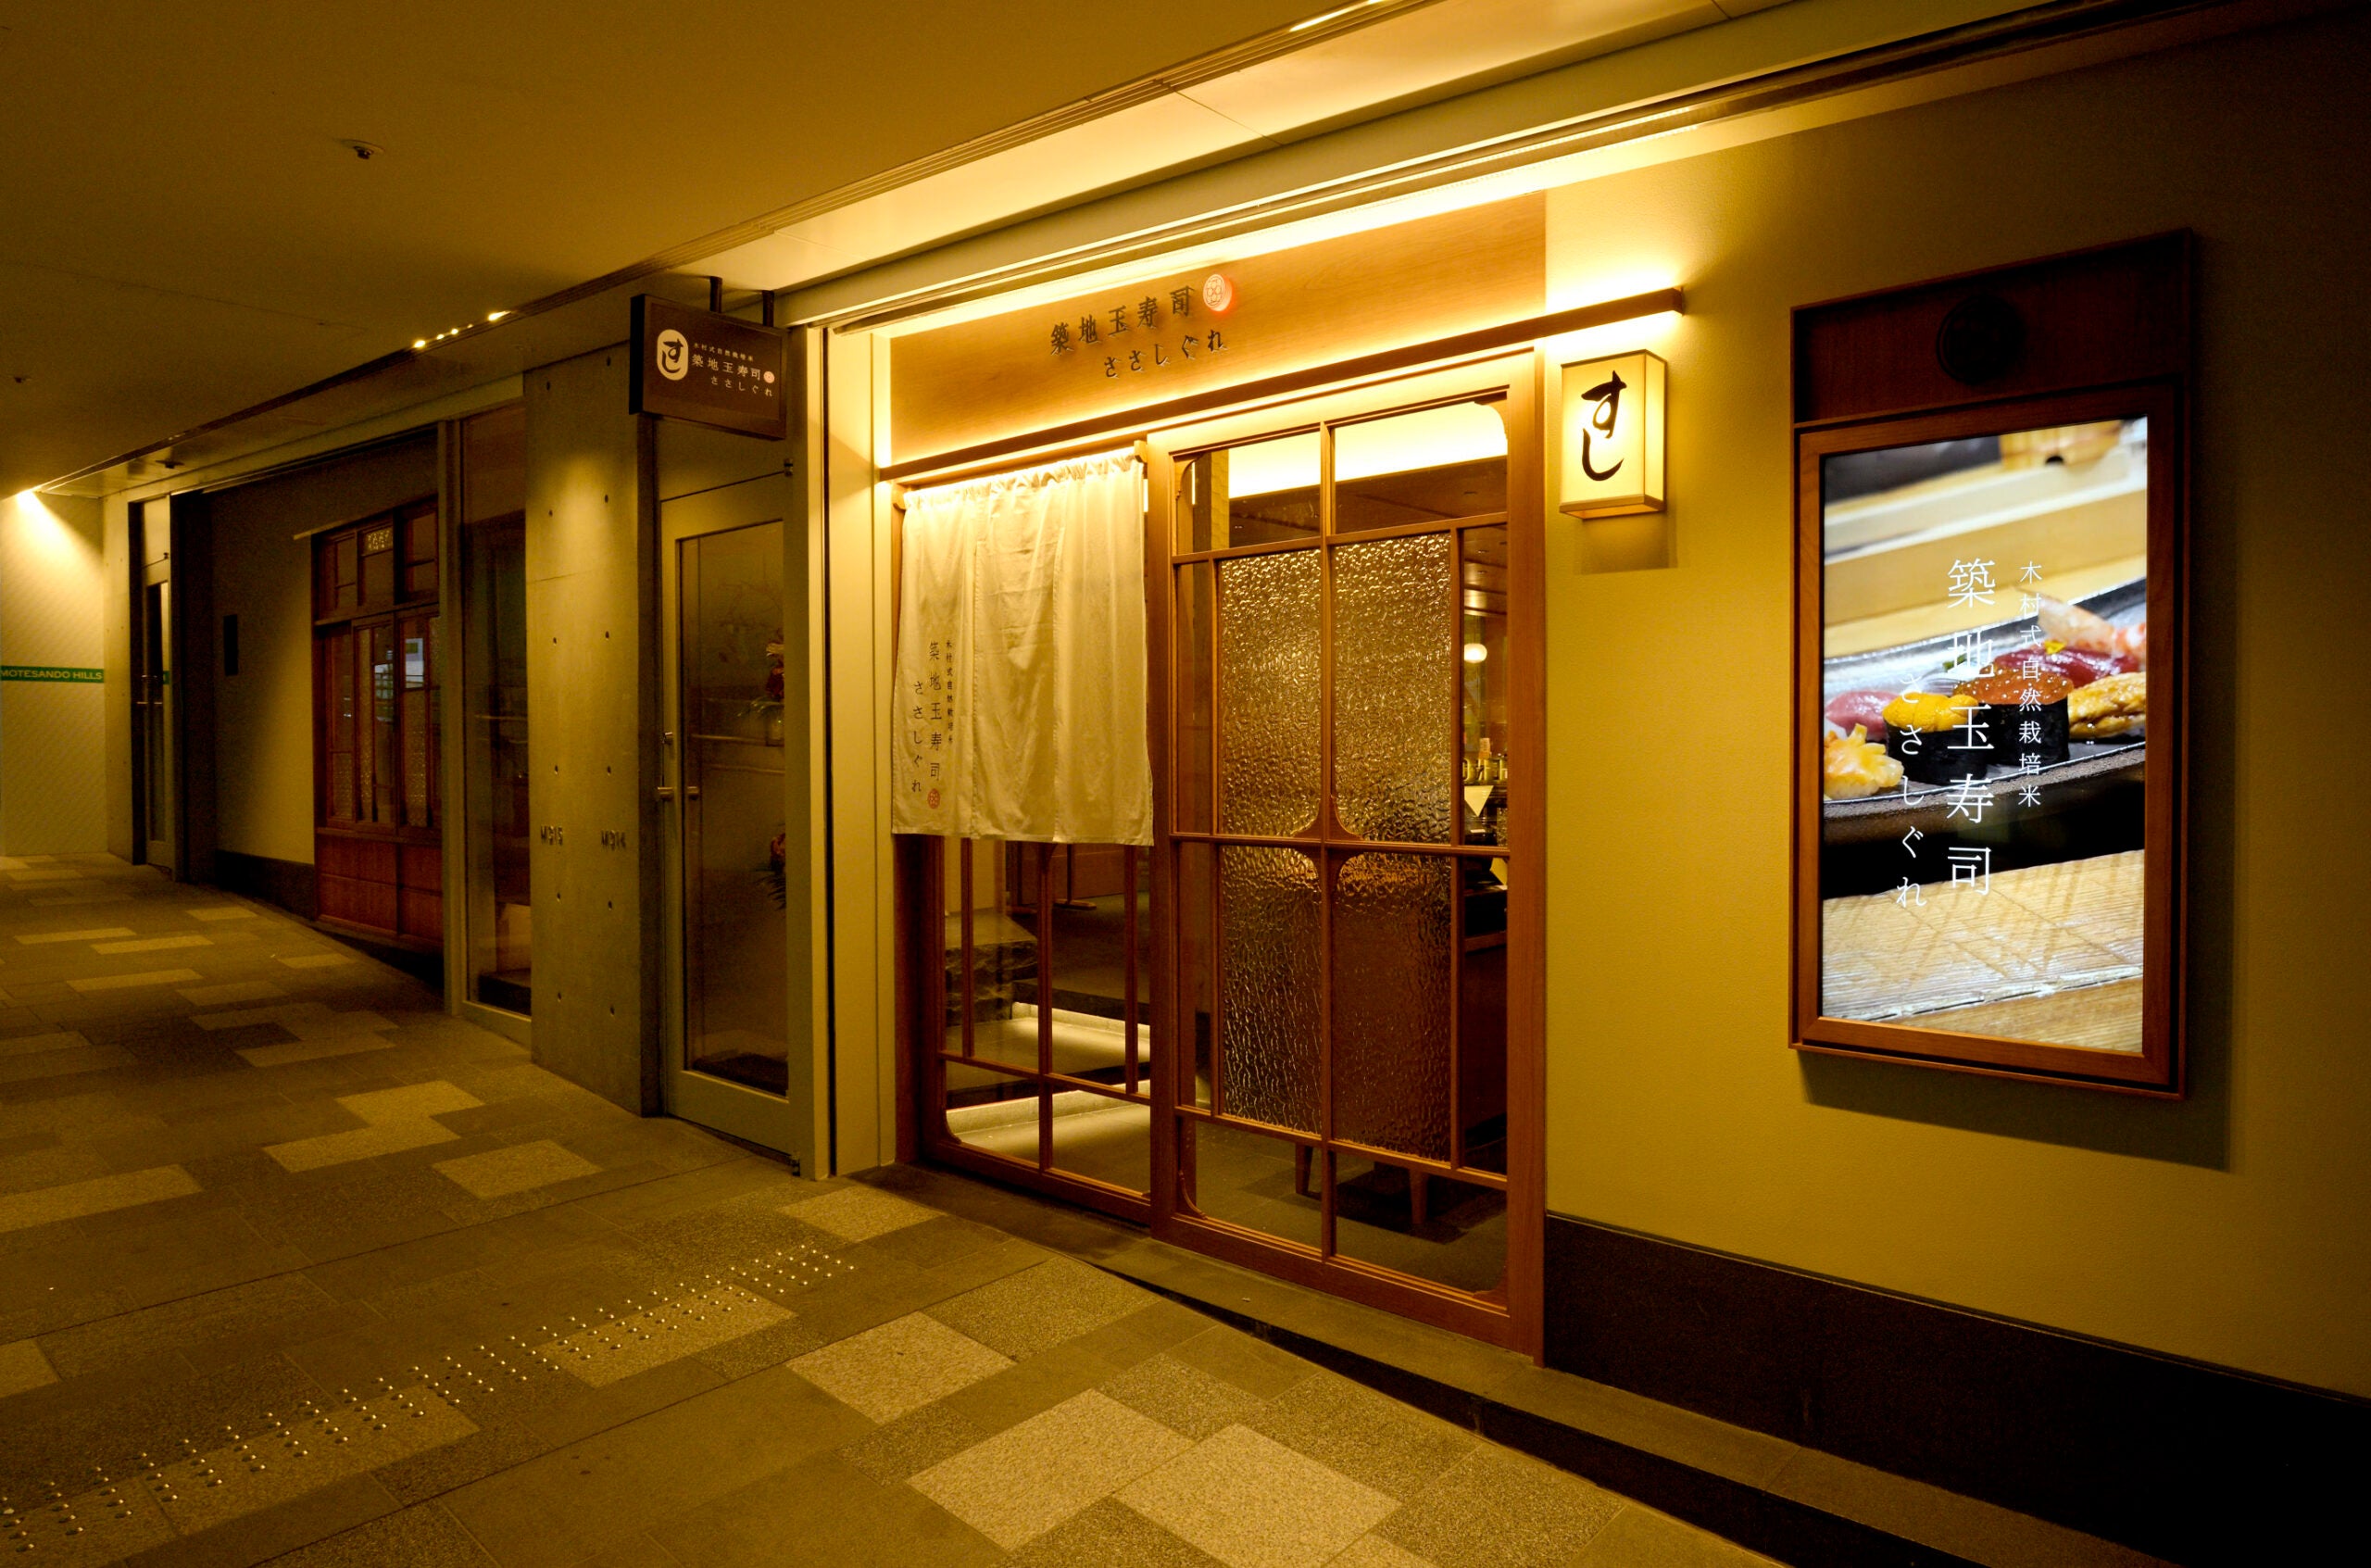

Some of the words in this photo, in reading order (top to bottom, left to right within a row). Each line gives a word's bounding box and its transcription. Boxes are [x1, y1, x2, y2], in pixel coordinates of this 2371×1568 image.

[662, 338, 684, 373] すし
[1050, 285, 1195, 355] 築地玉寿司
[1104, 330, 1224, 378] ささしぐれ
[692, 354, 761, 381] 築地玉寿司
[710, 375, 772, 397] ささしぐれ
[1581, 370, 1627, 481] すし
[73, 671, 103, 680] HILLS
[929, 641, 942, 781] 築地玉寿司
[2018, 560, 2042, 808] 木村式自然栽培米
[911, 681, 923, 792] ささしぐれ
[1946, 558, 1996, 896] 築地玉寿司
[1896, 672, 1926, 908] ささしぐれ
